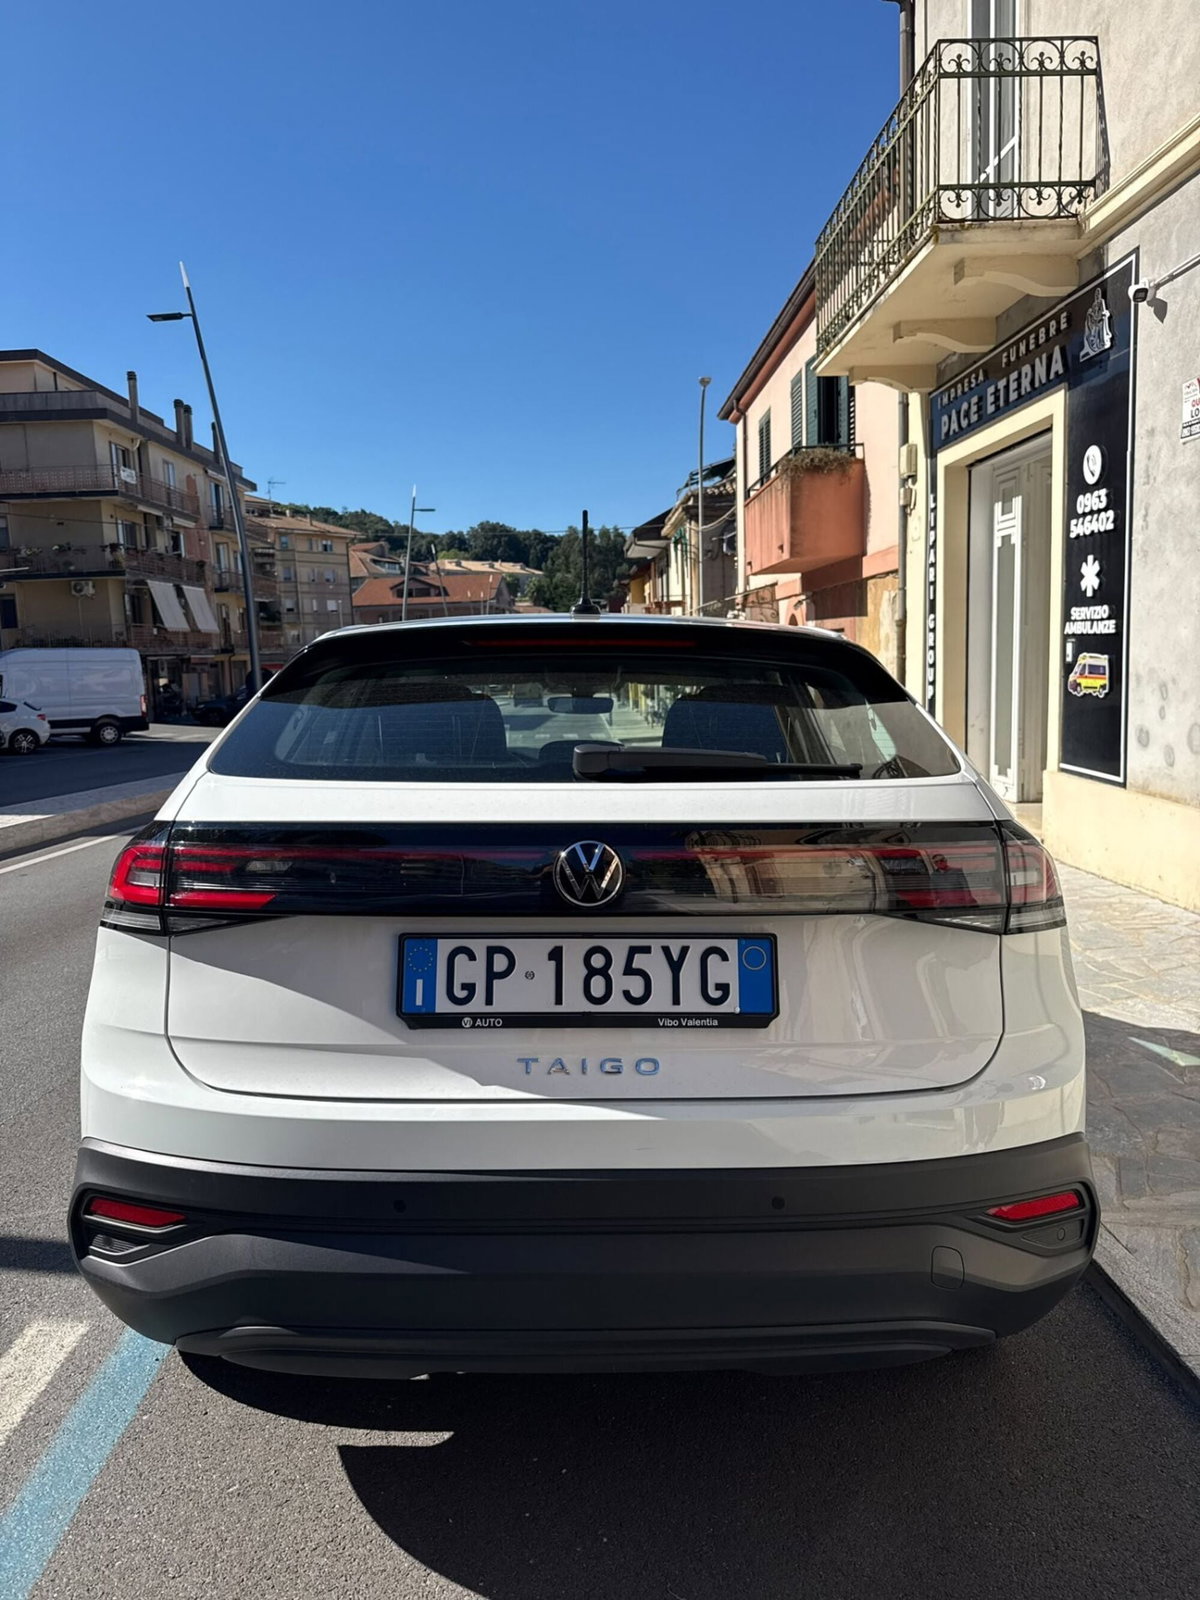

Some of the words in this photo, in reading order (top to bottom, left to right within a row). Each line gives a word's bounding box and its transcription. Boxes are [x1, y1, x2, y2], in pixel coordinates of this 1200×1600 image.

[938, 368, 984, 410] IMPRESA
[1001, 311, 1068, 368] FUNEBRE
[941, 394, 979, 440] PACE
[986, 345, 1064, 415] ETERNA
[1076, 488, 1107, 514] 0963
[1069, 509, 1115, 539] 546402
[928, 494, 936, 600] LIPARI
[1070, 604, 1110, 621] SERVIZIO
[1064, 619, 1117, 635] AMBULANZE
[927, 613, 936, 700] GROUP
[474, 1017, 503, 1028] AUTO
[657, 1017, 679, 1027] Vibo
[680, 1017, 719, 1027] Valentia
[516, 1057, 661, 1076] TAIGO
